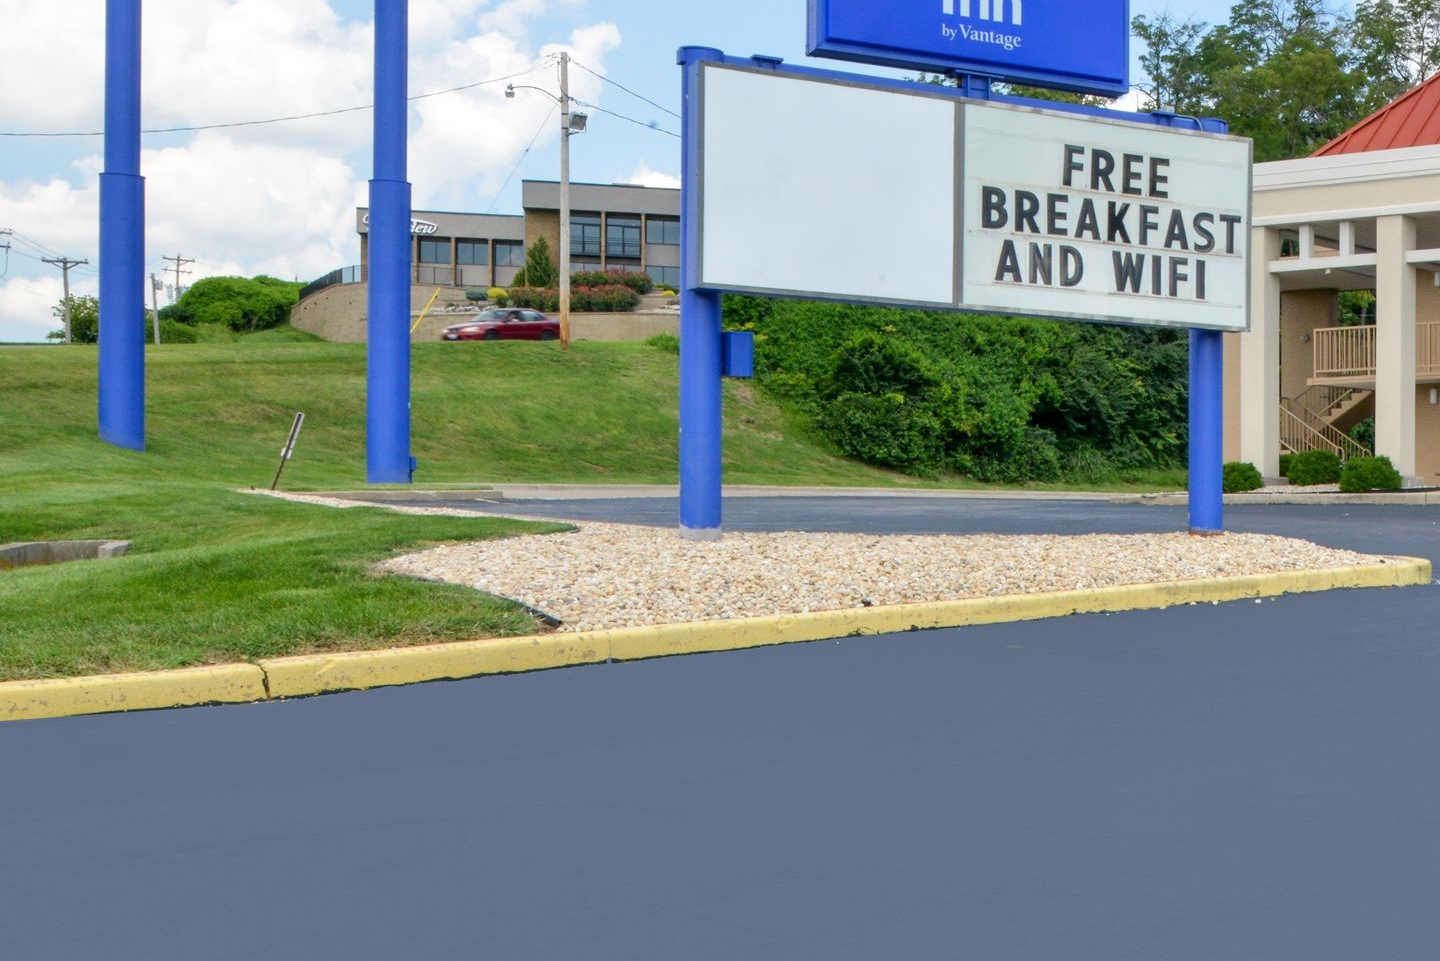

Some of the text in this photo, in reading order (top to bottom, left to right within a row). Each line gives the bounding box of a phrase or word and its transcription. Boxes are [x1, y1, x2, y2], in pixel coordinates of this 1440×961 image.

[942, 23, 1021, 50] by Vantage
[1063, 143, 1170, 199] FREE
[981, 185, 1242, 255] BREAKFAST
[994, 239, 1206, 300] AND WIFI
